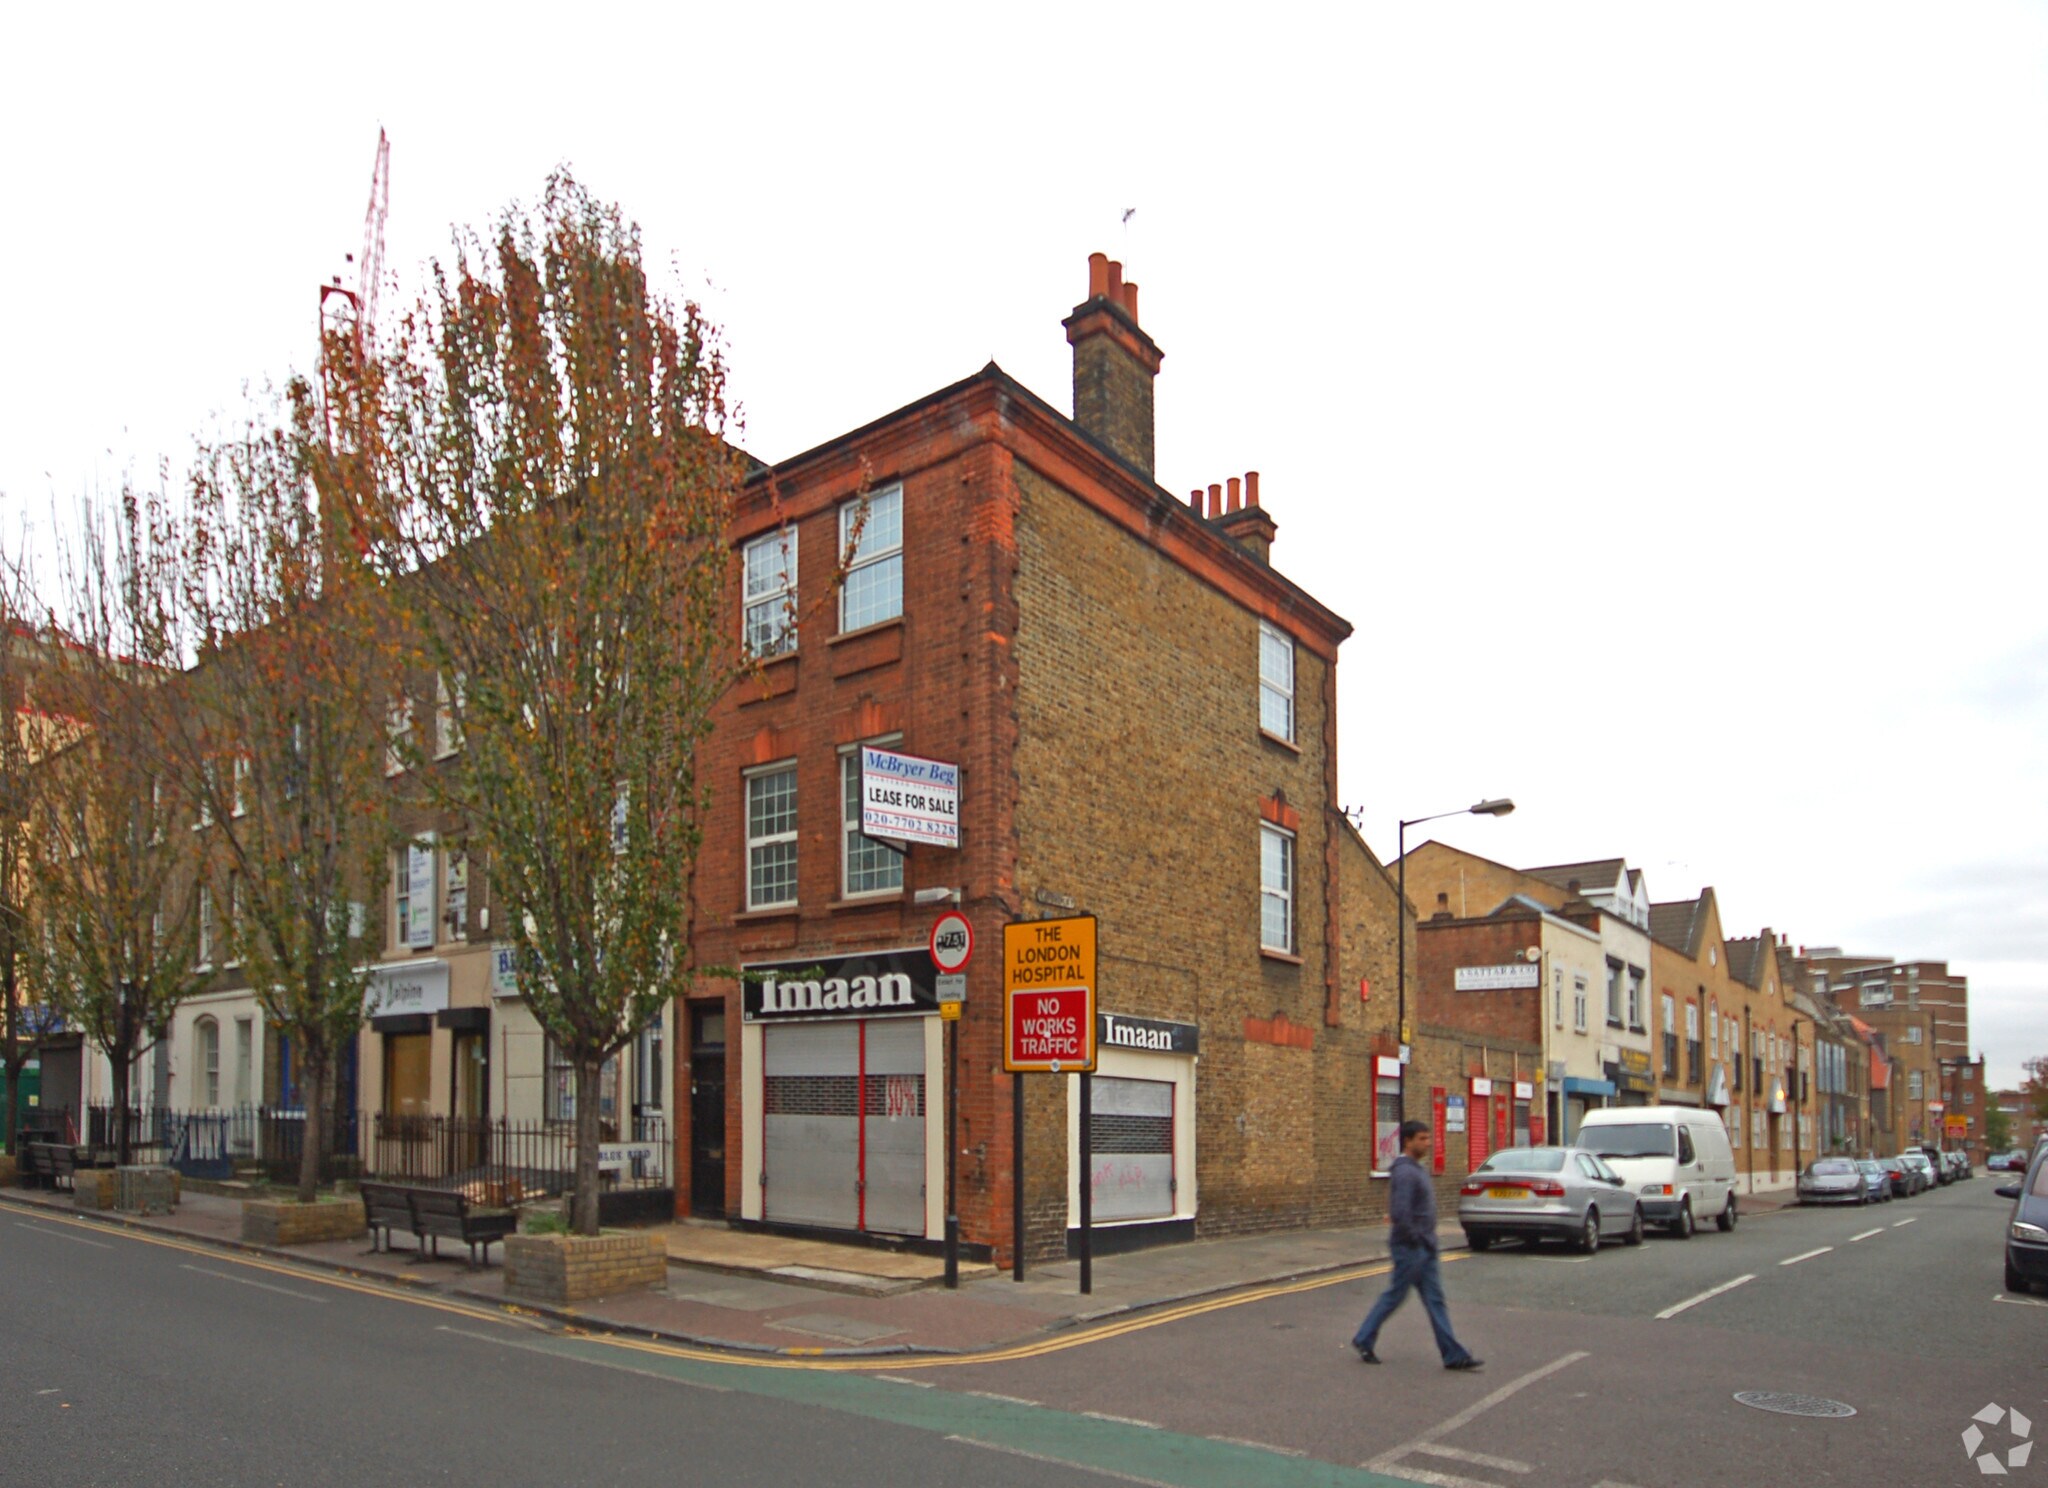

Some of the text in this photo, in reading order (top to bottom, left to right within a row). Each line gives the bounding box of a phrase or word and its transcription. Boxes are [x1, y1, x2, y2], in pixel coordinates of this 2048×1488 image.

[868, 752, 955, 786] McBryer Beg
[869, 787, 955, 815] LEASE FOR SALE
[1035, 926, 1062, 943] THE
[1017, 945, 1081, 964] LONDON
[1012, 965, 1085, 984] HOSPITAL
[759, 970, 916, 1013] Imaan
[1037, 998, 1060, 1016] NO
[1022, 1017, 1076, 1036] WORKS
[1104, 1015, 1173, 1050] Imaan
[1021, 1037, 1078, 1055] TRAFFIC
